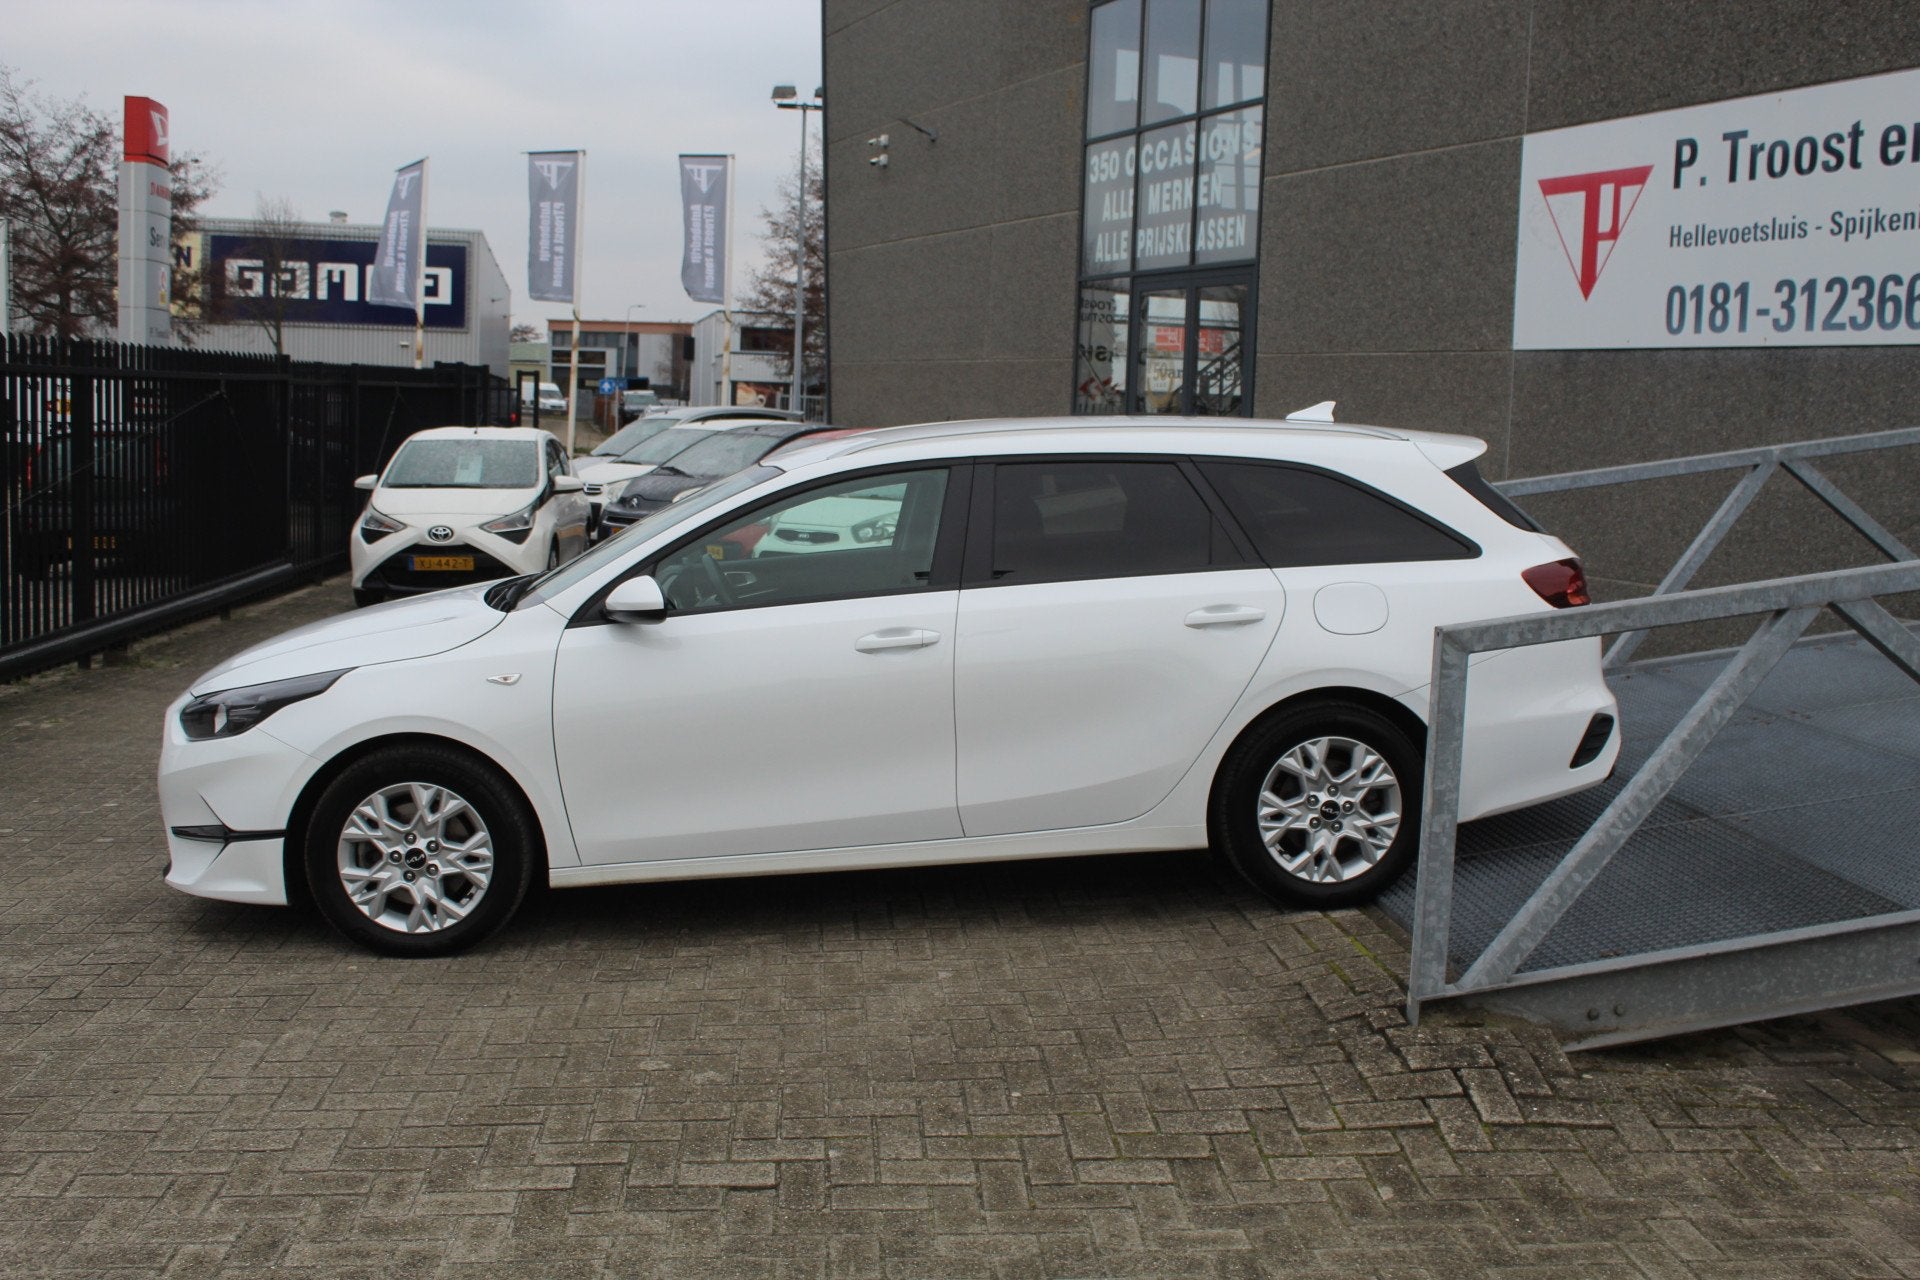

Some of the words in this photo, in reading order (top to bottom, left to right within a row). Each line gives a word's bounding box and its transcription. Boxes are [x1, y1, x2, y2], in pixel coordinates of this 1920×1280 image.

[1089, 150, 1120, 183] 350
[1125, 121, 1255, 177] OCCASIONS
[1673, 137, 1707, 189] P.
[1722, 120, 1865, 183] Troost
[1148, 172, 1222, 215] MERKEN
[1095, 230, 1129, 263] ALLE
[1669, 216, 1808, 249] Hellevoetsluis
